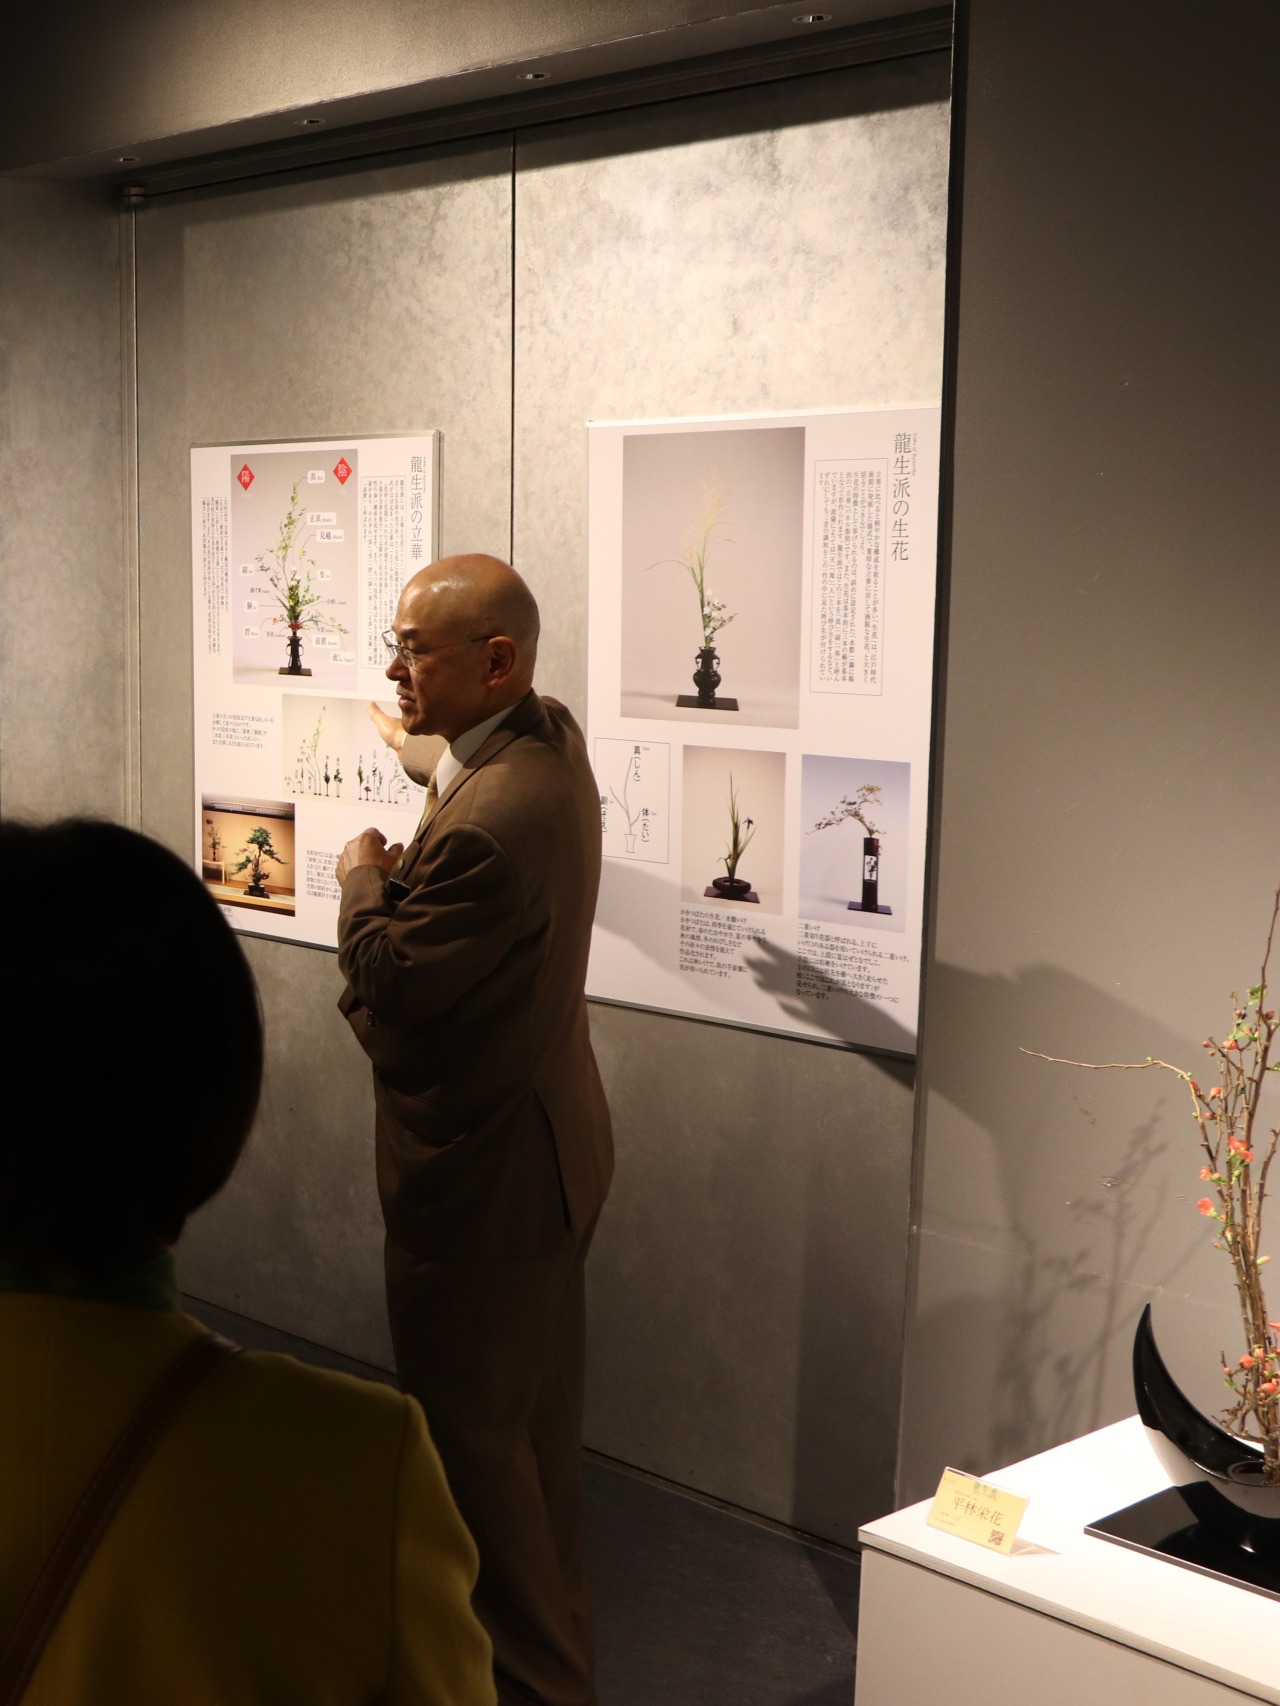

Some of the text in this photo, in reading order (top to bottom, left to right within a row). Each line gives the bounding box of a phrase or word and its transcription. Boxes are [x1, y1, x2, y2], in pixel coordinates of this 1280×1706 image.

[410, 455, 423, 561] 龍生派の立華
[891, 433, 913, 562] 龍生派の生花
